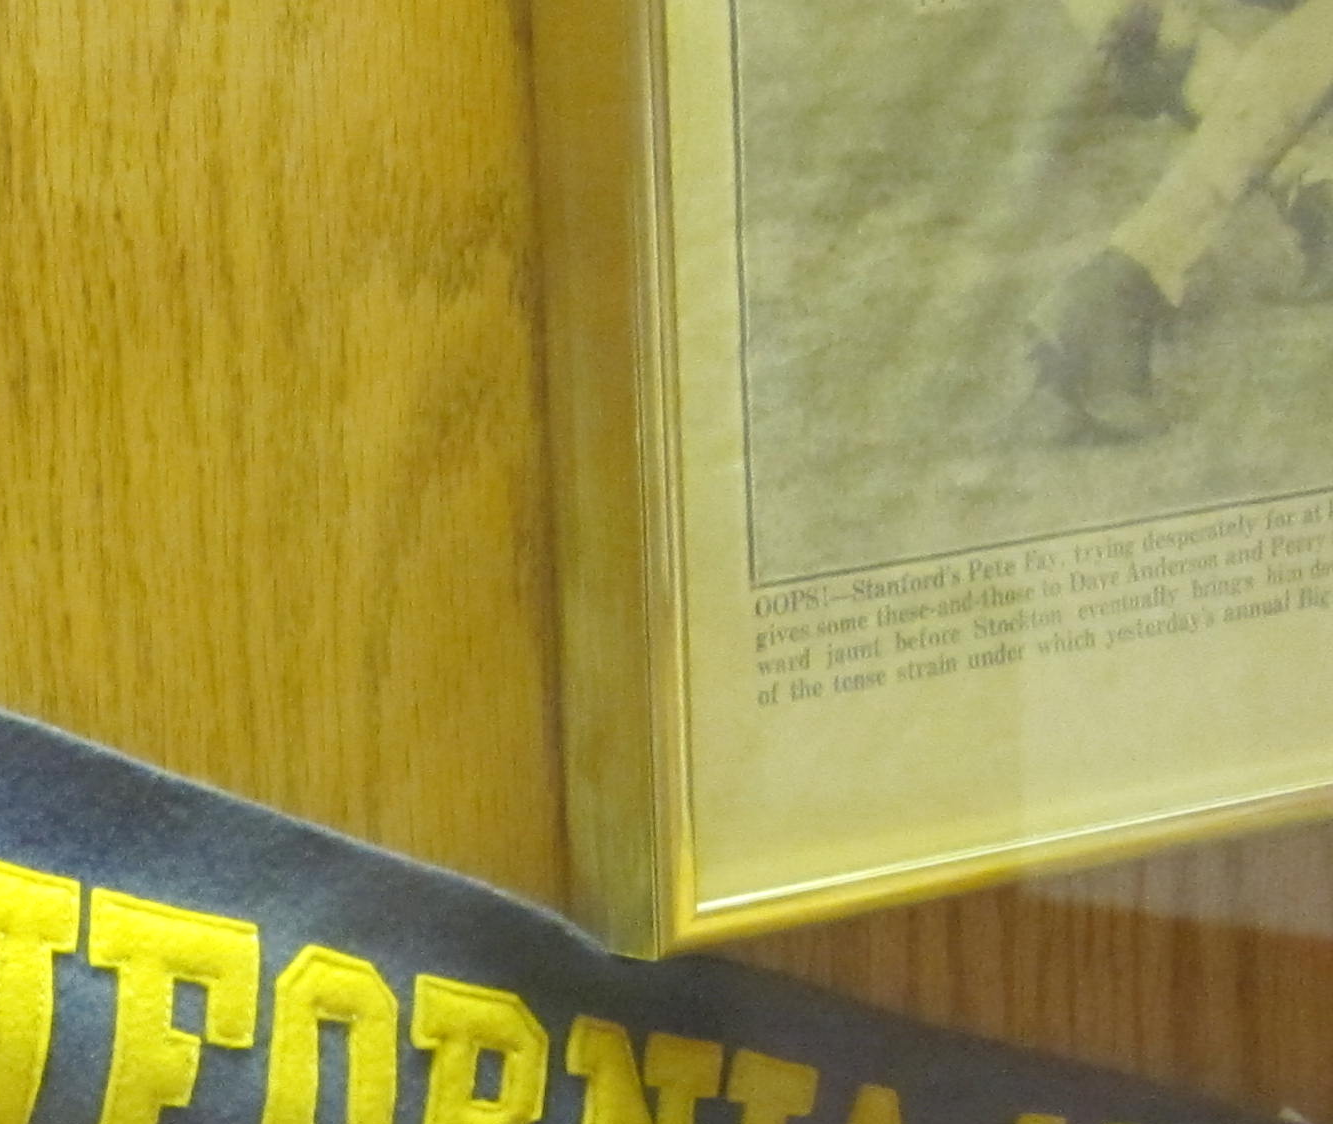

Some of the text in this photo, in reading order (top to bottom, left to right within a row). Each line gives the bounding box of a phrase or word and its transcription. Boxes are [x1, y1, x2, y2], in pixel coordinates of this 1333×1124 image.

[756, 624, 810, 653] gives
[817, 614, 870, 637] some
[1043, 579, 1062, 599] to
[1070, 568, 1120, 594] Dave
[1127, 553, 1218, 583] Anderson
[1225, 539, 1264, 567] and
[968, 558, 1016, 582] Pete
[1074, 538, 1136, 566] trying
[1142, 514, 1254, 551] desperately
[1303, 505, 1321, 524] at
[757, 647, 811, 676] ward
[826, 637, 881, 670] jaunt
[895, 625, 961, 652] before
[973, 607, 1063, 640] Stockton
[1078, 585, 1179, 621] eventually
[1192, 574, 1256, 601] brings
[757, 681, 780, 706] of
[789, 678, 824, 703] the
[833, 670, 887, 694] tense
[895, 654, 958, 682] strain
[968, 642, 1025, 671] under
[1038, 629, 1097, 655] which
[1106, 606, 1215, 650] yesterday's
[1222, 588, 1291, 623] annual
